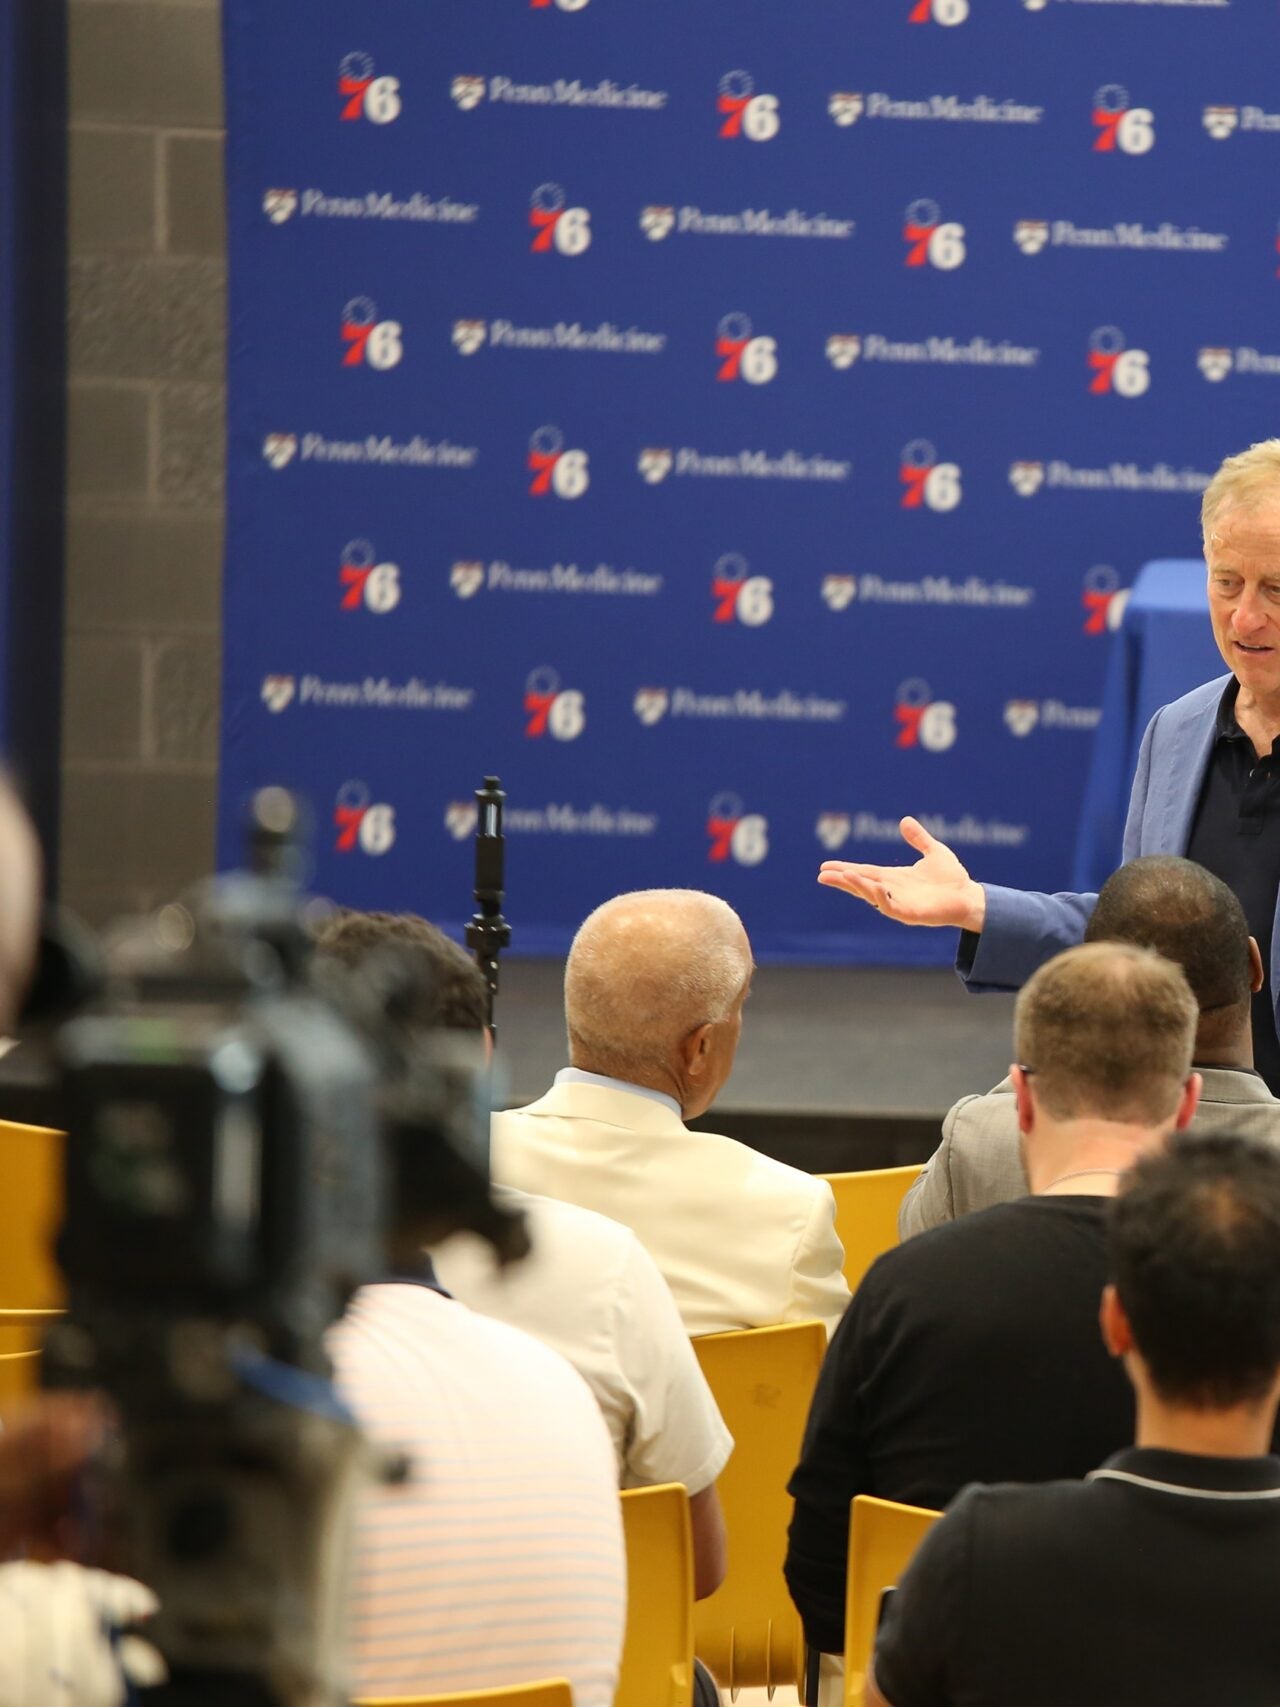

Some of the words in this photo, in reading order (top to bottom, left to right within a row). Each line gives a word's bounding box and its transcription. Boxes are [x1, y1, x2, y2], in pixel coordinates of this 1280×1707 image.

[339, 74, 401, 124] 76
[717, 91, 780, 141] 76
[1092, 105, 1155, 155] 76
[529, 207, 591, 256] 76
[903, 219, 966, 270] 76
[341, 319, 402, 370] 76
[715, 333, 778, 385] 76
[1087, 346, 1150, 397] 76
[528, 448, 589, 499] 76
[900, 461, 962, 512] 76
[340, 563, 400, 613] 76
[712, 576, 773, 626] 76
[524, 690, 585, 740] 76
[895, 701, 956, 751] 76
[335, 805, 394, 853] 76
[708, 815, 768, 864] 76
